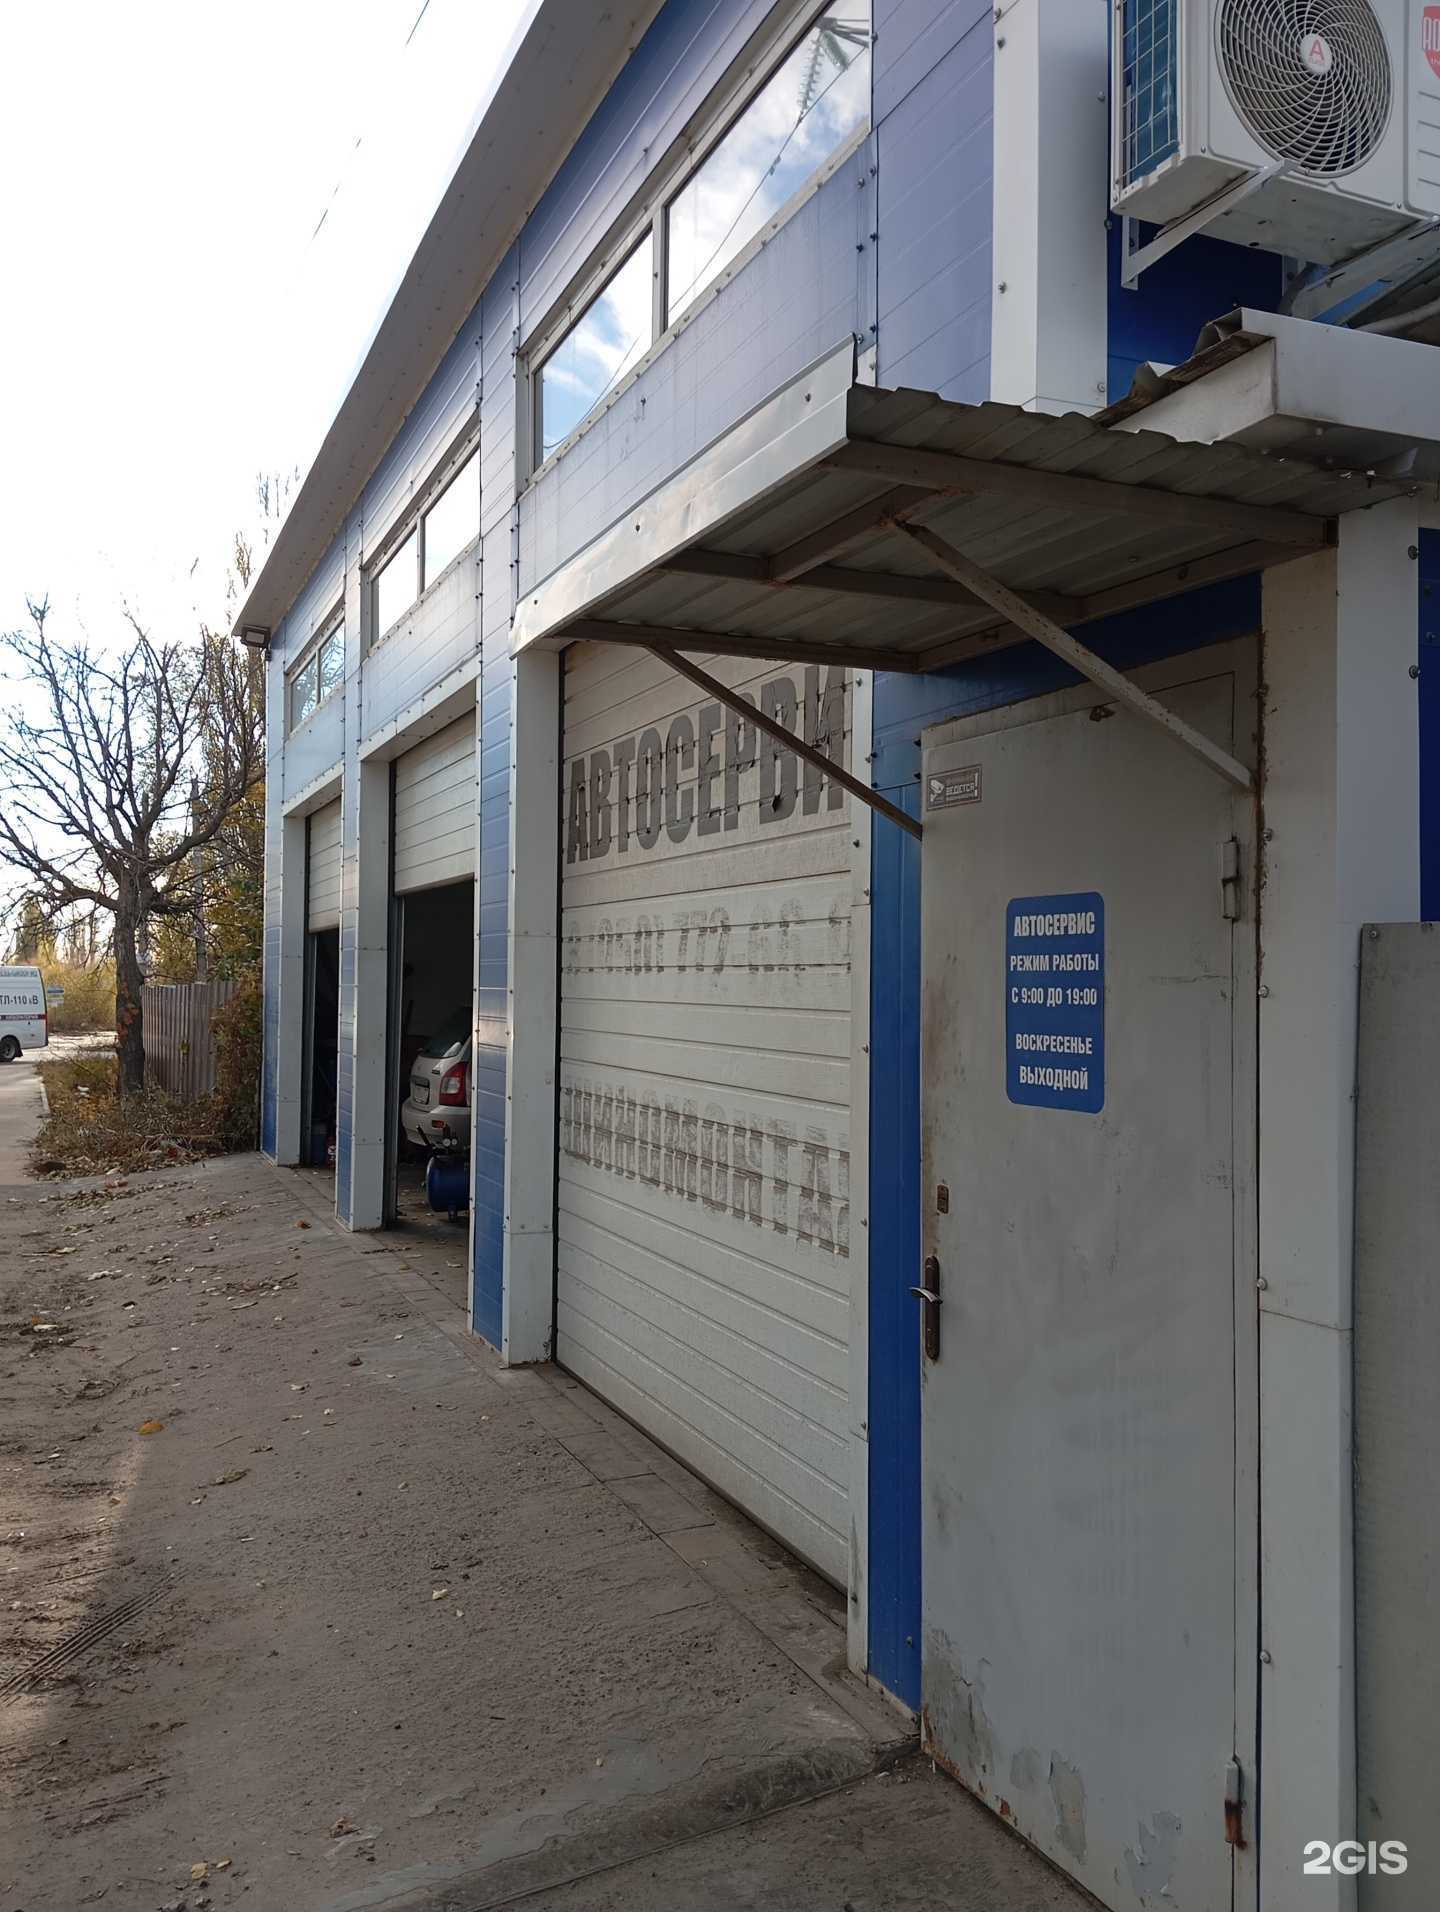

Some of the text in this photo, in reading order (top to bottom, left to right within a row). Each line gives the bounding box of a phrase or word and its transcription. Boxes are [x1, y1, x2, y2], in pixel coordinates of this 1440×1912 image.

[1014, 911, 1095, 937] АВТОСЕРВИС
[1010, 953, 1100, 972] РЕЖИМ РАБОТЫ
[1011, 987, 1098, 1008] С 9:00 ДО 19:00
[1015, 1033, 1093, 1055] ВОСКРЕСЕНЬЕ
[1019, 1065, 1089, 1091] ВЫХОДНОЙ
